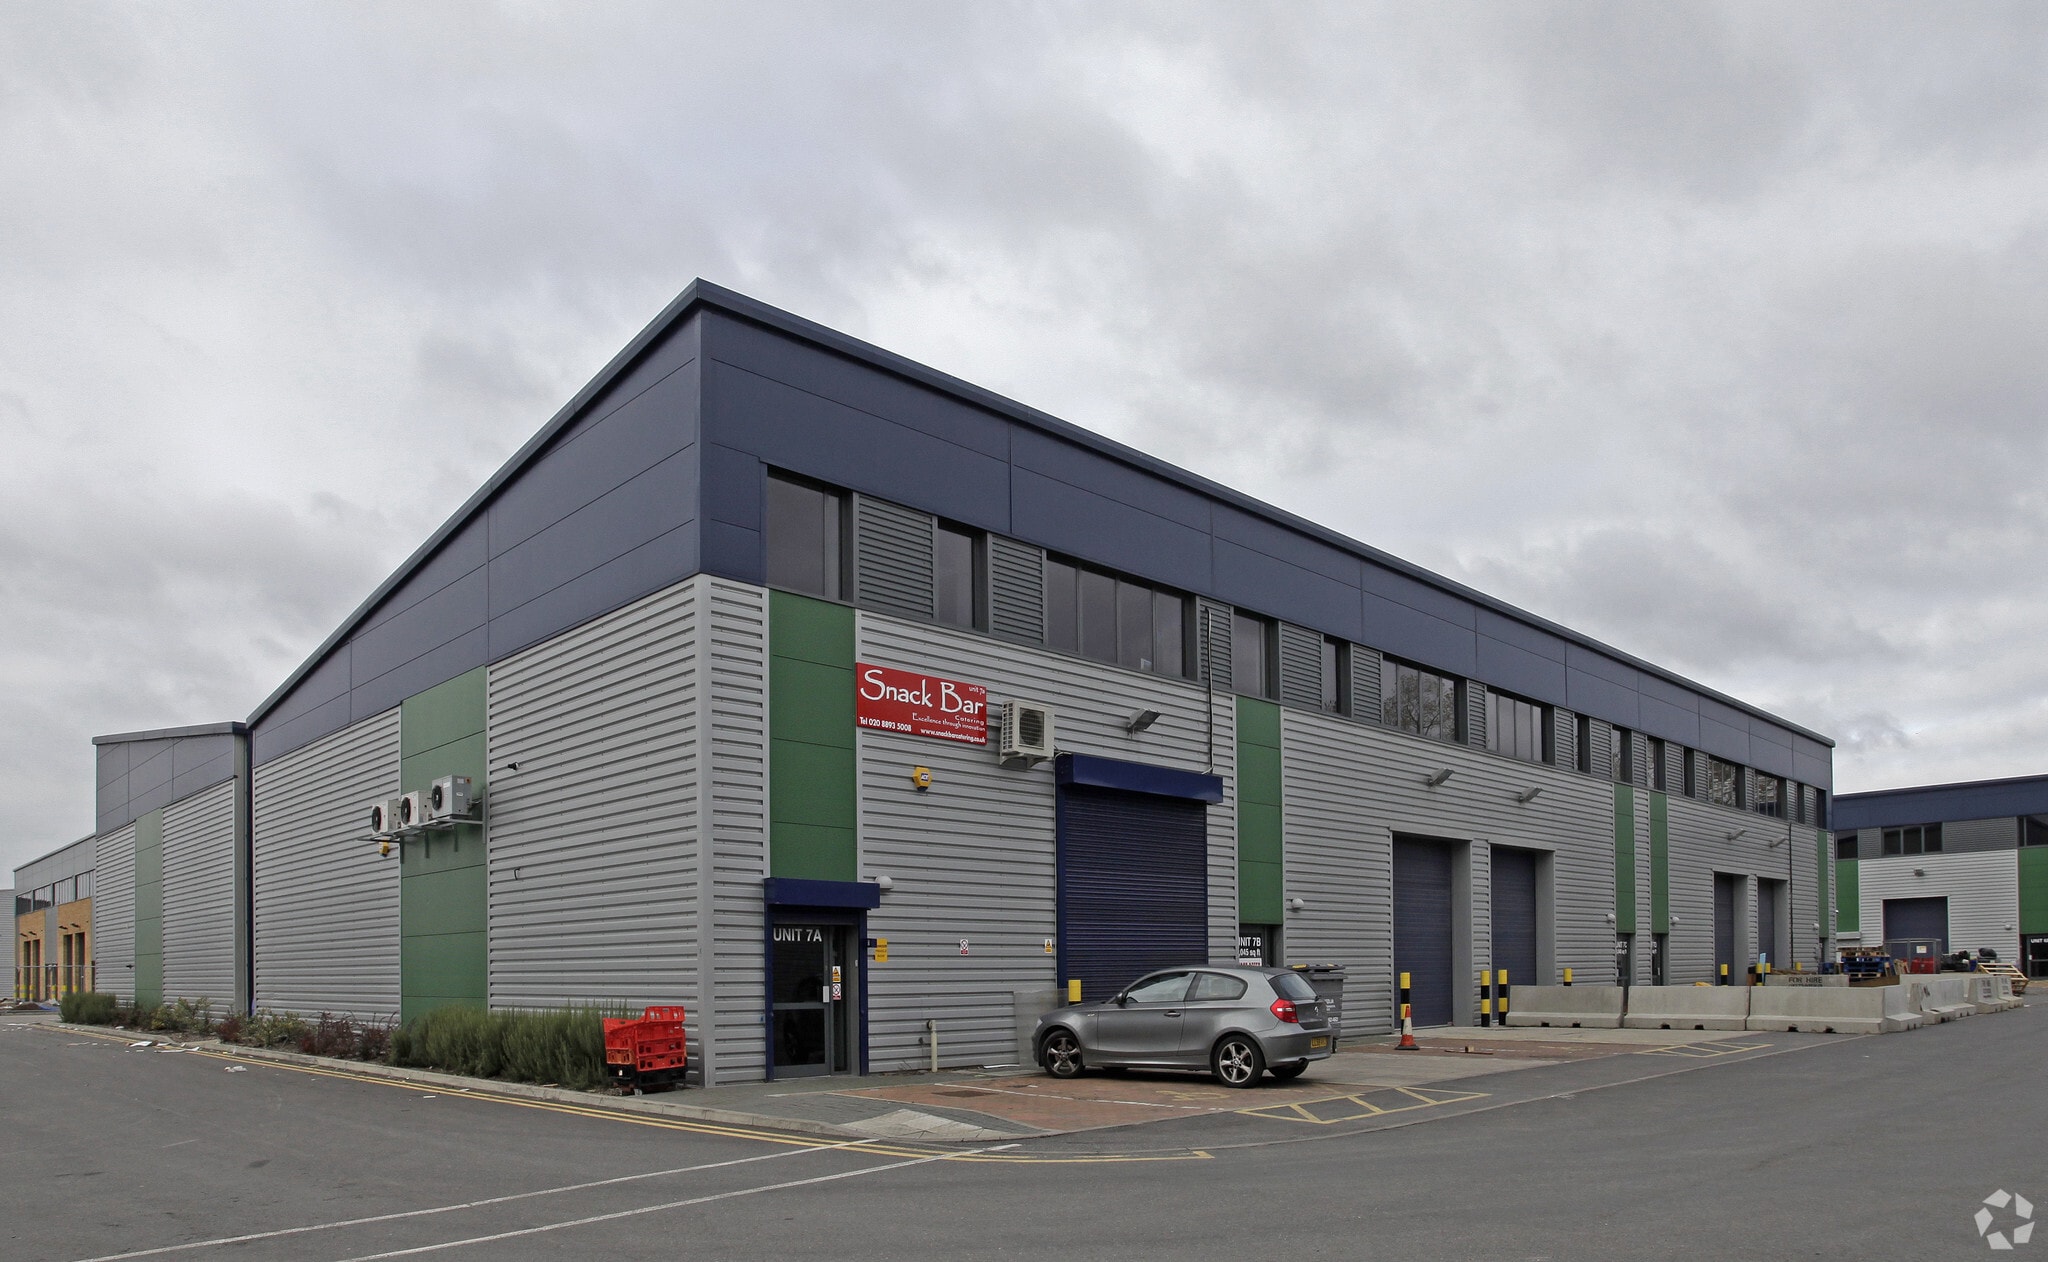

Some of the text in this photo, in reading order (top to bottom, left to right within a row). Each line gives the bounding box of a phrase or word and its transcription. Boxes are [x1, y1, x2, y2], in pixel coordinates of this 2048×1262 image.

[860, 669, 984, 714] Snack Bar
[859, 716, 912, 732] Tel 020 8893 5008
[912, 712, 986, 732] Excellence through innovation
[954, 714, 985, 726] Catering
[920, 728, 986, 743] www.snackbarcatering.co.uk
[773, 927, 822, 942] UNIT 7A
[1252, 937, 1261, 947] 7B
[1805, 976, 1823, 984] HIRE
